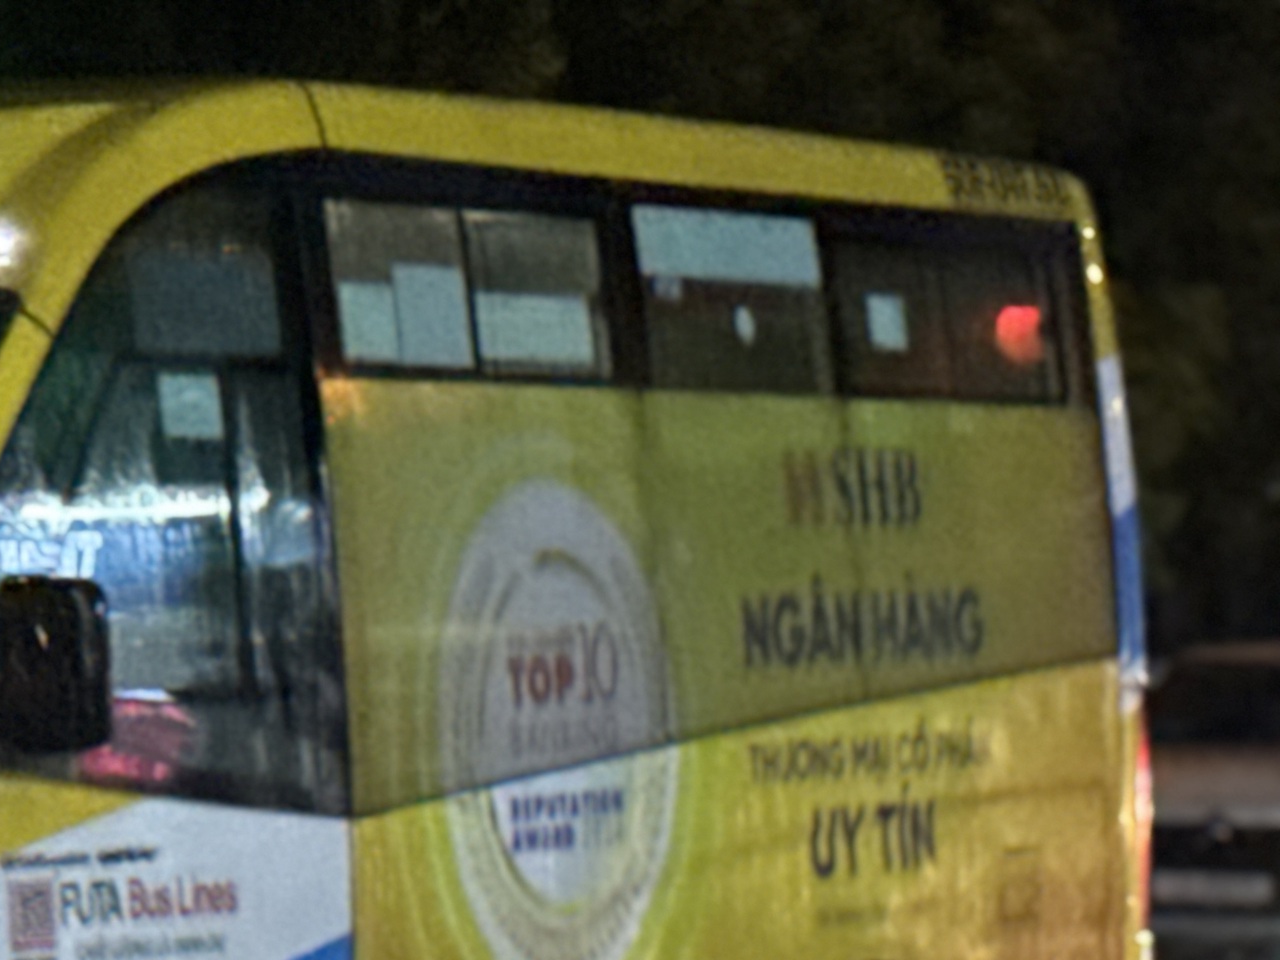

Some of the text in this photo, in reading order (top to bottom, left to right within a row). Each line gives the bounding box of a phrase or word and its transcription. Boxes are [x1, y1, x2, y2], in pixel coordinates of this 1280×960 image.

[832, 447, 921, 528] SHB
[741, 572, 983, 669] NGÂN HÀNG
[508, 622, 617, 708] TOP 10
[810, 780, 937, 878] UY TÍN
[125, 876, 172, 919] Bus
